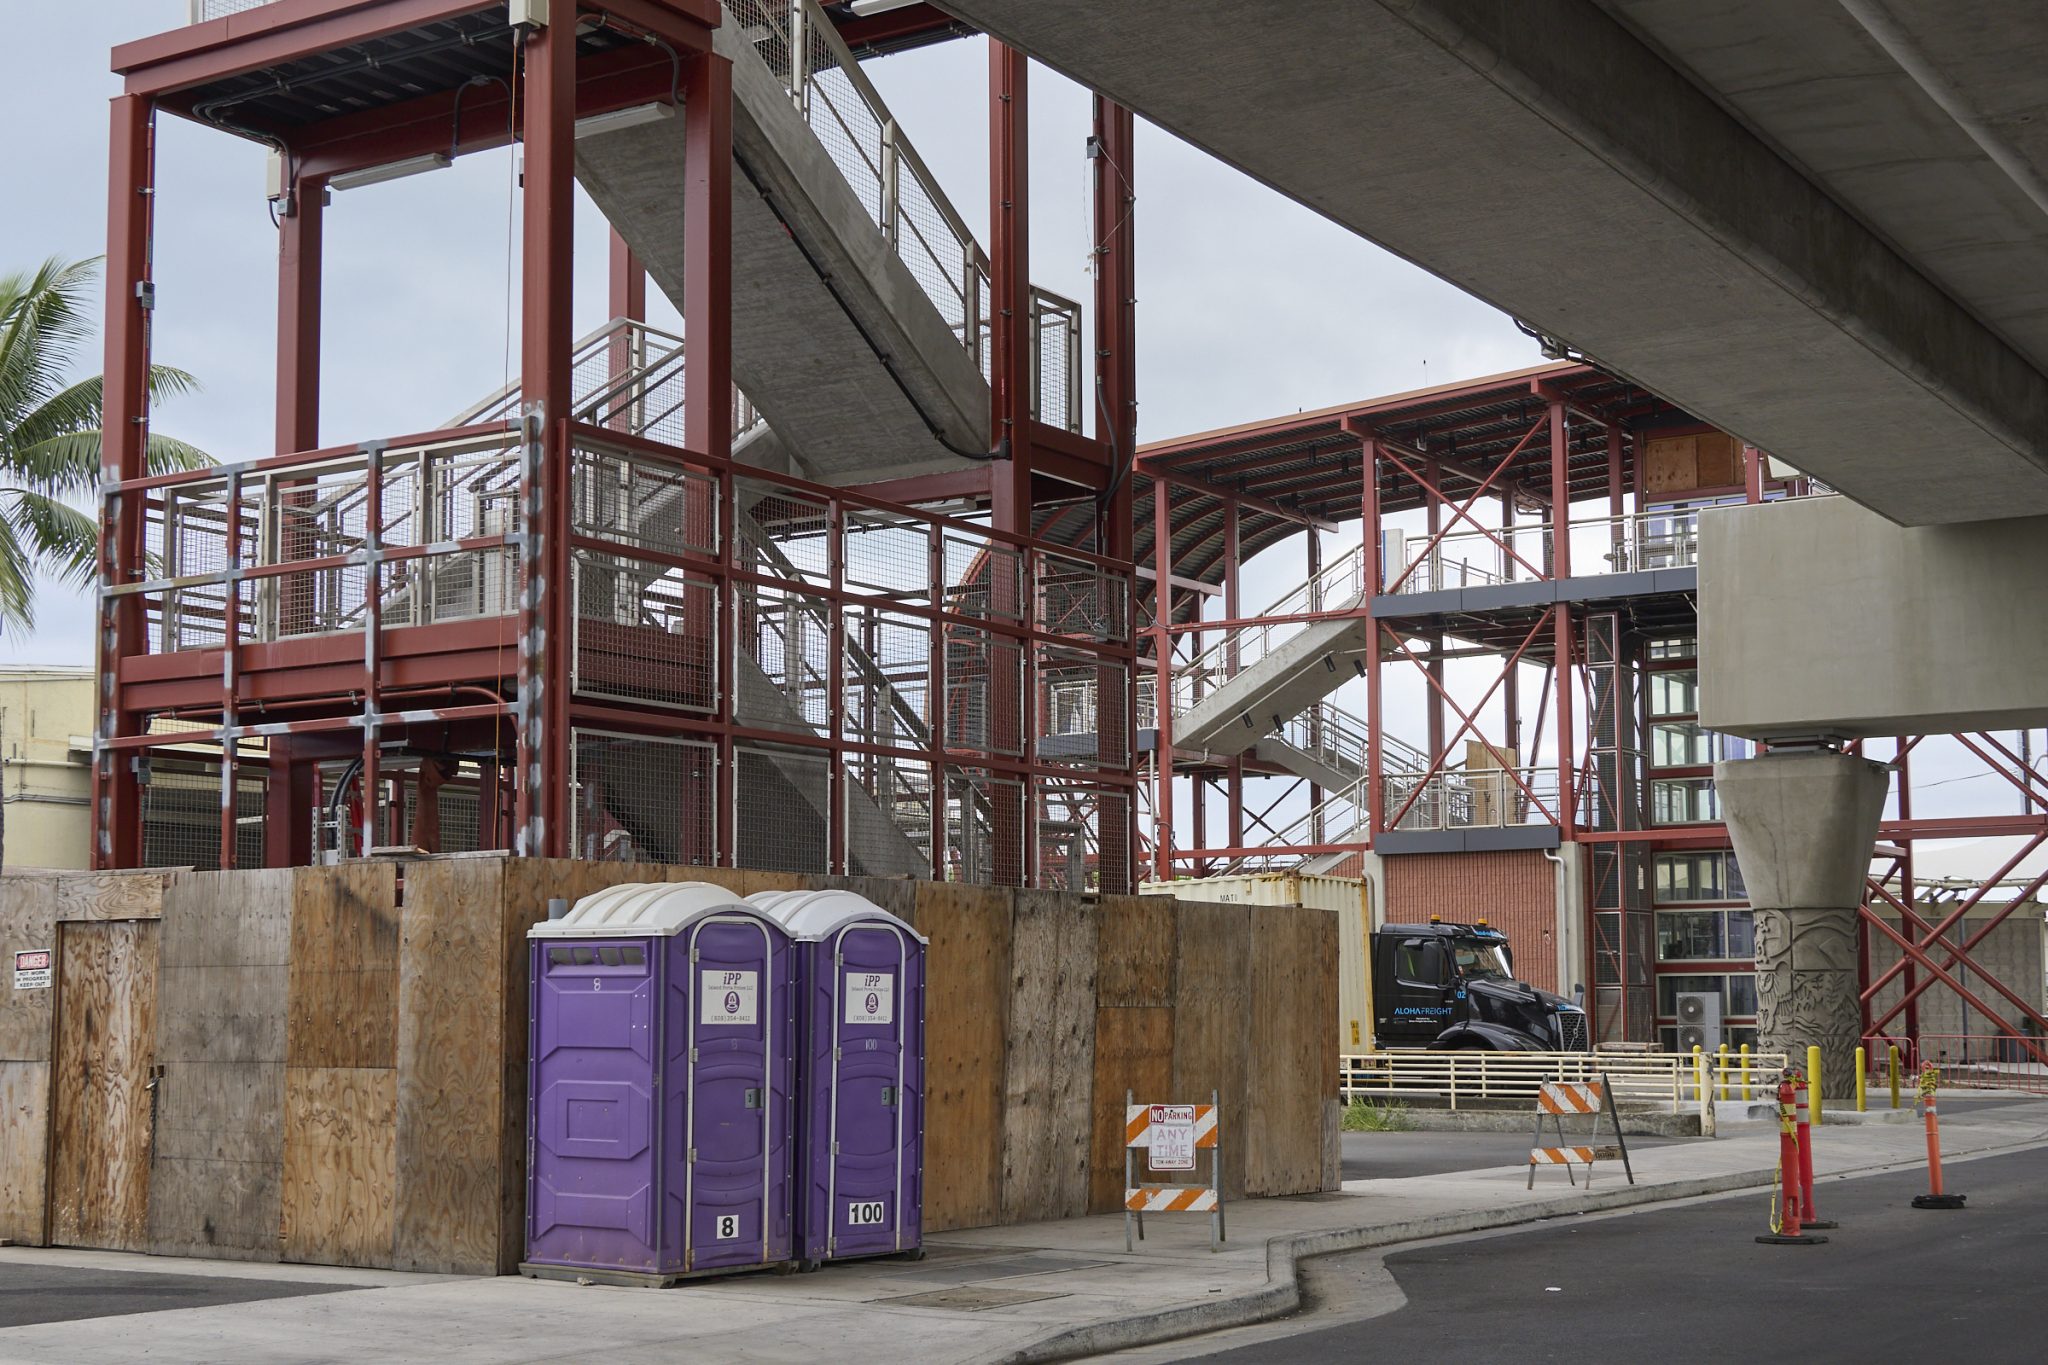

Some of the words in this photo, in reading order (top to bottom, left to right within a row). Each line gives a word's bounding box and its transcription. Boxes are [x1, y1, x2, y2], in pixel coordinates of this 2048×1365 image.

[20, 954, 48, 969] DANGER
[593, 977, 601, 992] 8
[723, 972, 742, 985] iPP
[864, 975, 881, 987] iPP
[1457, 991, 1466, 999] 02
[865, 1039, 878, 1051] 100
[1152, 1109, 1164, 1122] NO
[1164, 1111, 1192, 1120] PARKING
[1157, 1129, 1187, 1140] ANY
[1157, 1144, 1188, 1157] TIME
[851, 1203, 883, 1223] 100
[721, 1216, 734, 1237] 8
